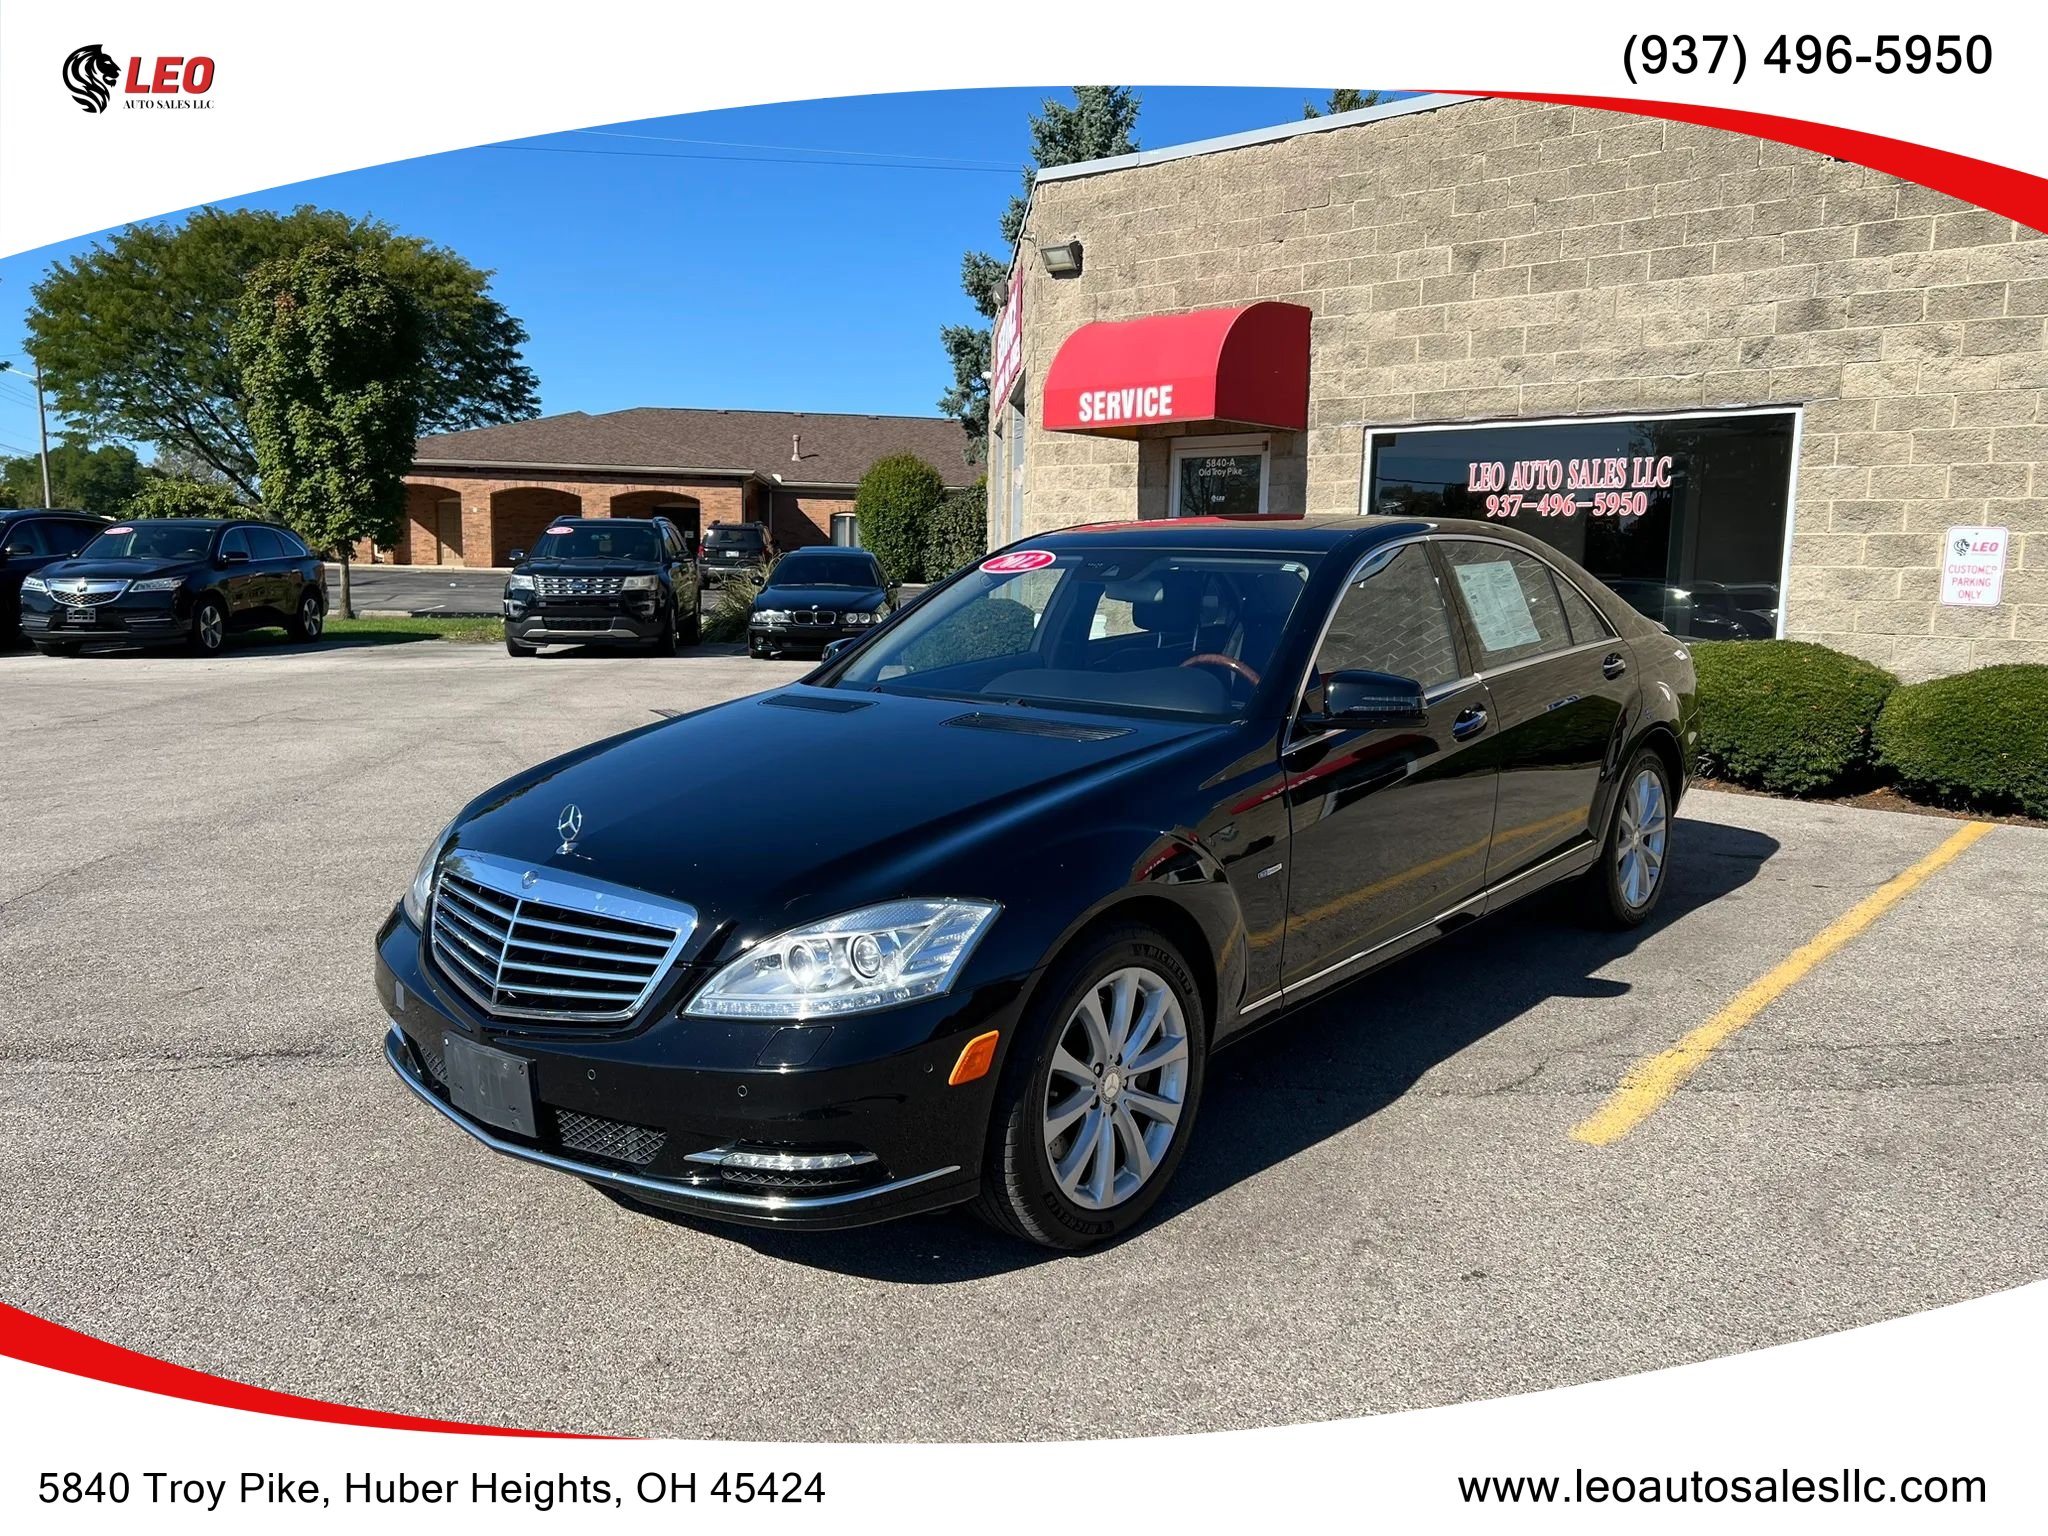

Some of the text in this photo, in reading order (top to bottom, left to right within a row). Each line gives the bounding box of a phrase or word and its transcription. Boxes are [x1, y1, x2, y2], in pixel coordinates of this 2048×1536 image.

[1078, 385, 1174, 422] SERVICE
[1205, 457, 1236, 468] 5840-A
[1198, 468, 1211, 477] Old
[1227, 467, 1243, 476] Pike
[1467, 456, 1673, 492] LEO AUTO SALES LLC
[1486, 492, 1649, 518] 937-496-5950
[1971, 541, 1999, 552] LEO
[1951, 577, 1992, 587] PARKING
[1958, 589, 1982, 600] ONLY
[1147, 945, 1194, 995] MICHELIN
